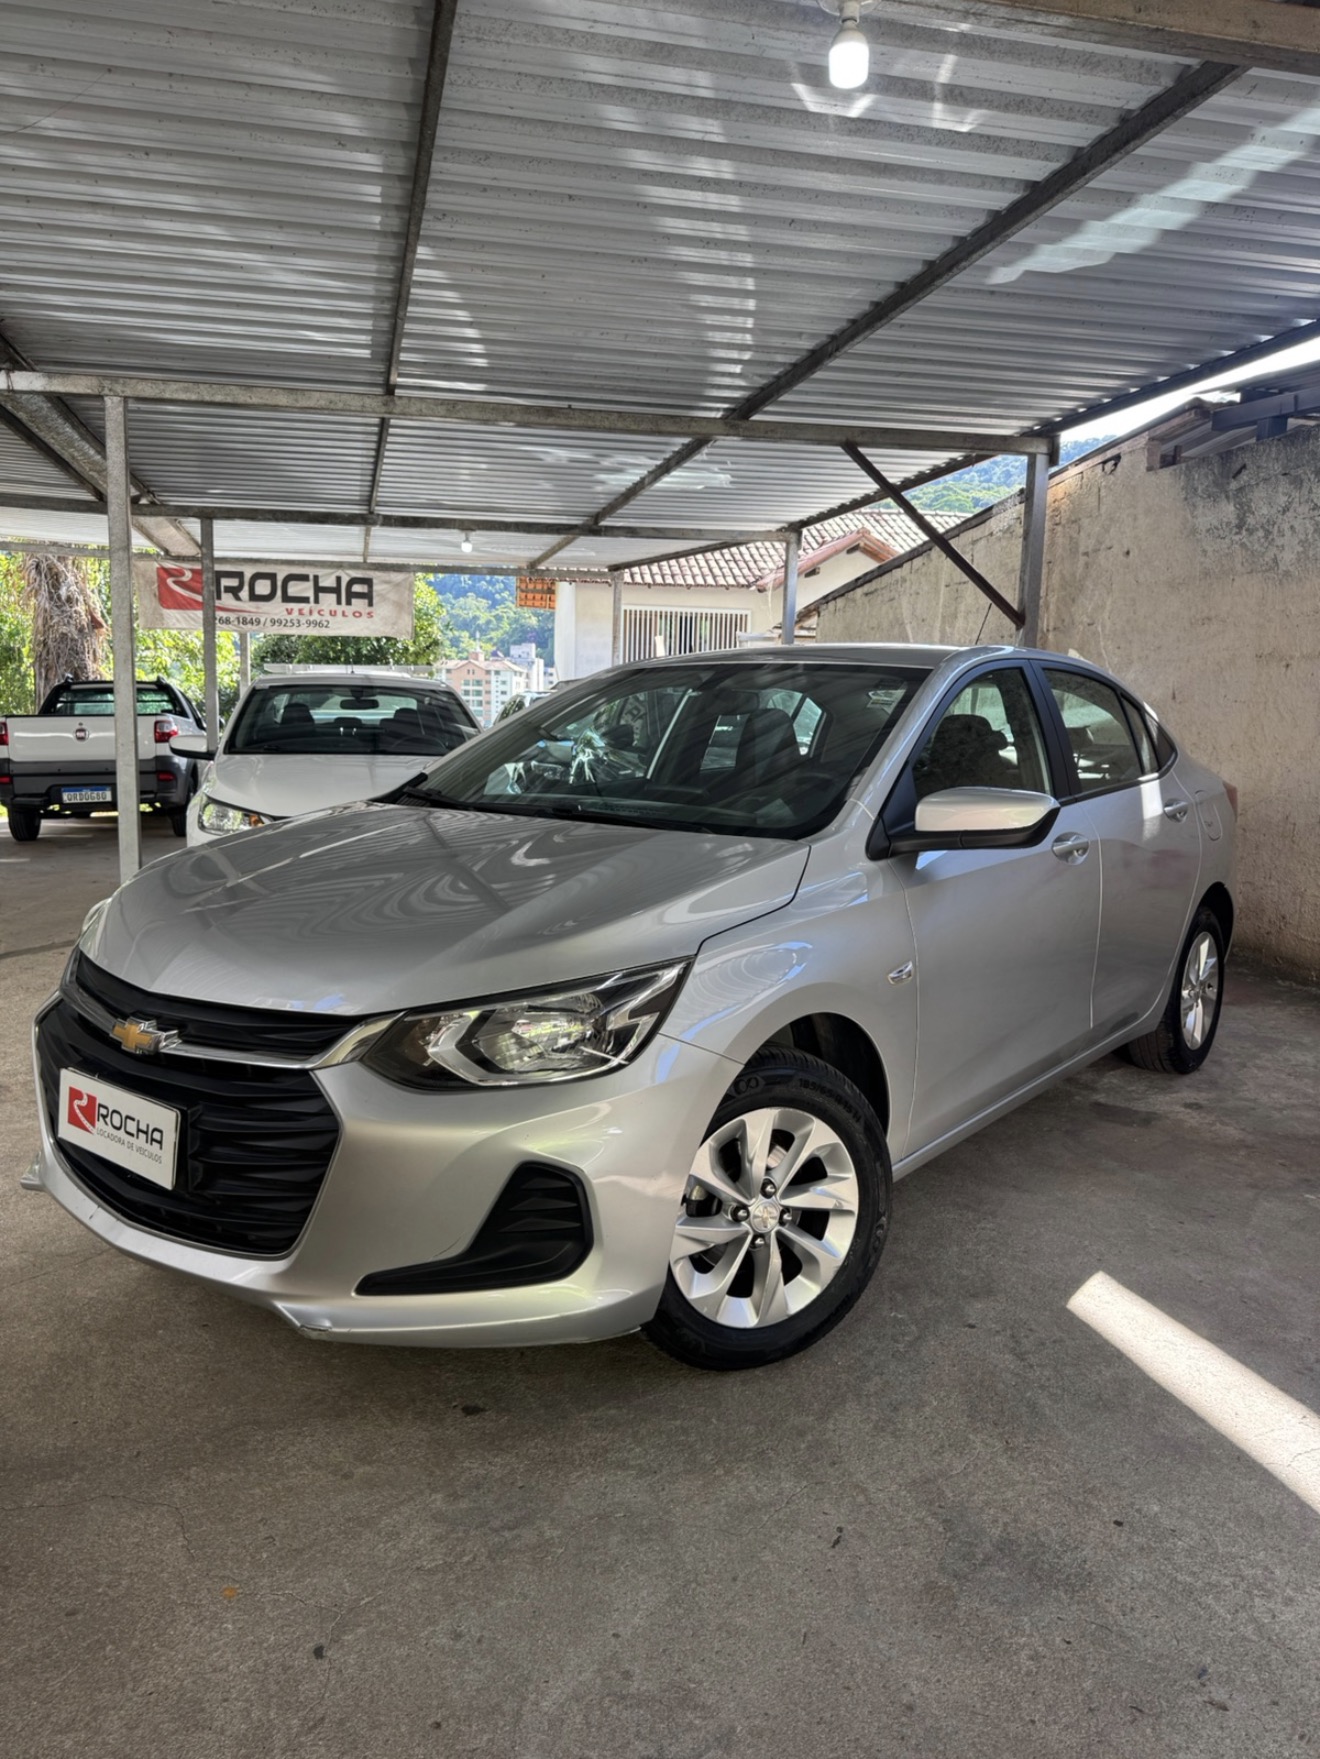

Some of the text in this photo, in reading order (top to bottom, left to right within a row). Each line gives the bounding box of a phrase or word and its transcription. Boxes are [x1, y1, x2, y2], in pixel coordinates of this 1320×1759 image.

[215, 570, 373, 607] ROCHA
[269, 617, 331, 629] 99253-9962
[286, 607, 374, 618] VEÍCULOS
[97, 1103, 163, 1150] ROCHA
[96, 1127, 125, 1146] LOCADORA
[127, 1140, 134, 1151] DE
